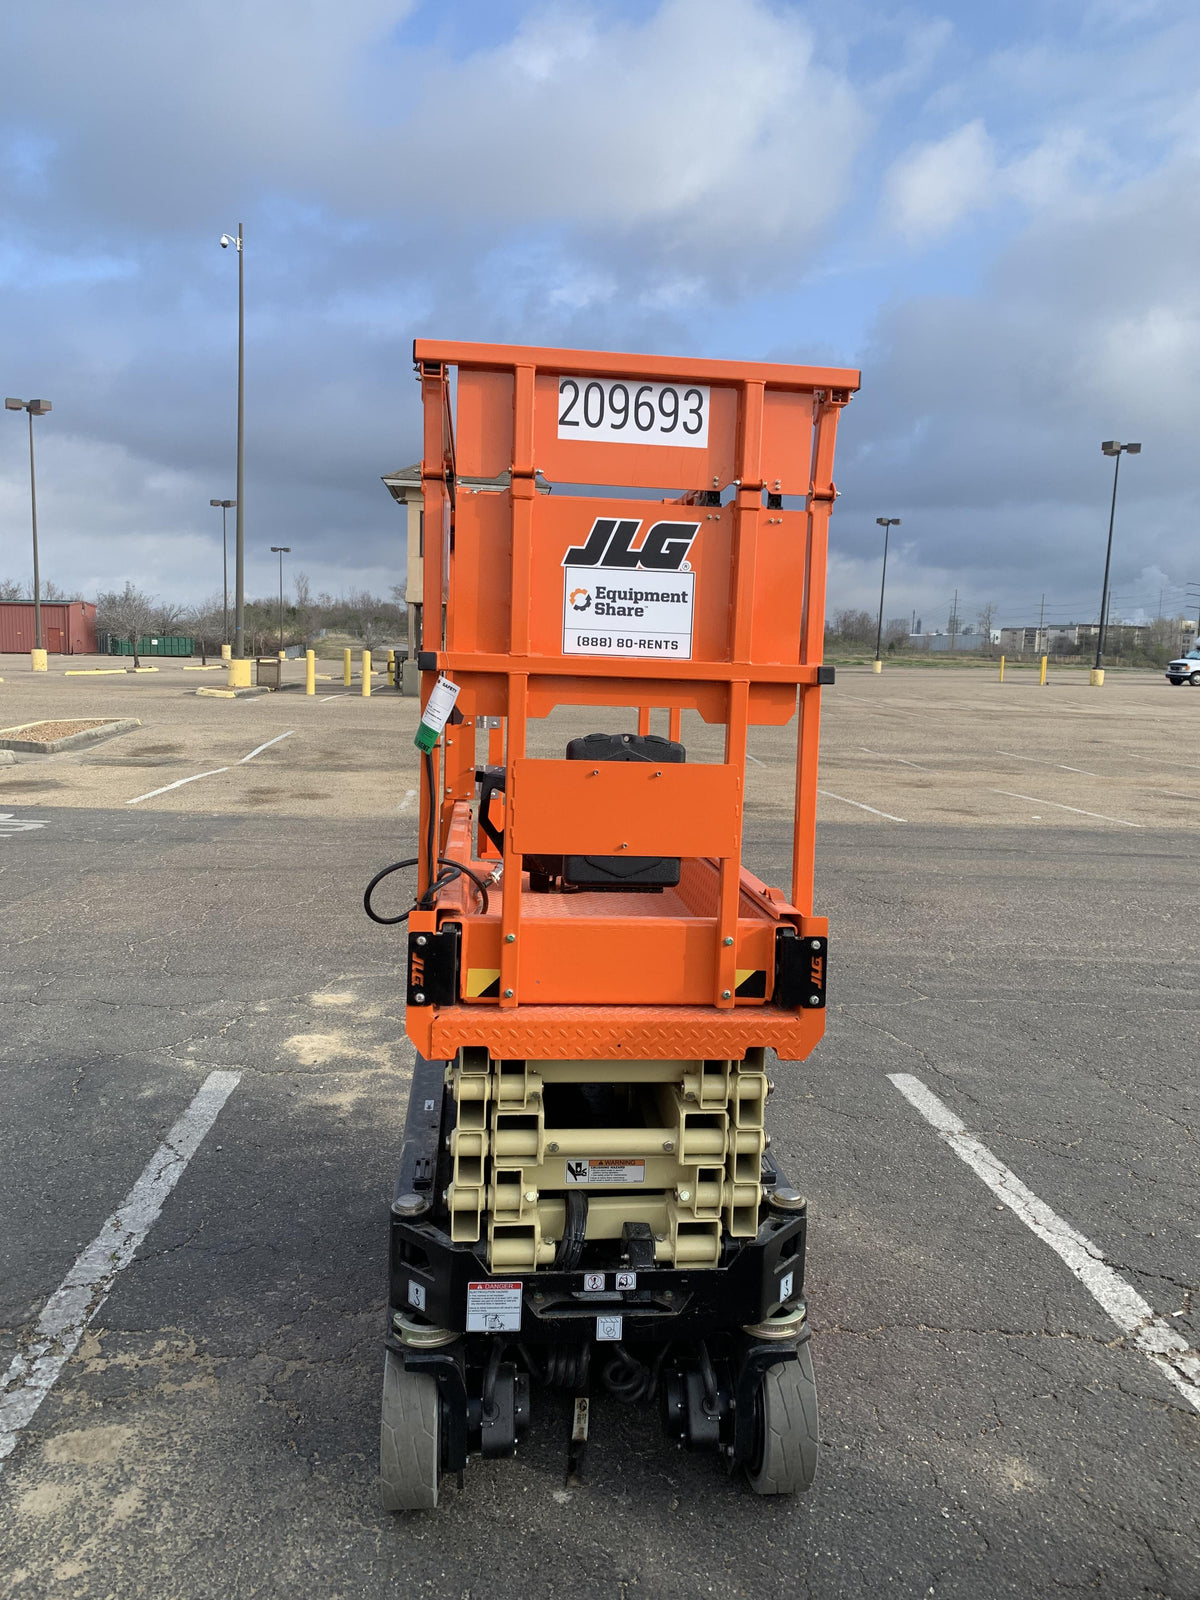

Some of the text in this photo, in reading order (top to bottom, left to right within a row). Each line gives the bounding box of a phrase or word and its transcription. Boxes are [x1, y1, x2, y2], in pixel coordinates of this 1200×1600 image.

[558, 379, 704, 435] 209693
[562, 518, 701, 571] JLG
[594, 586, 689, 605] Equipment
[594, 602, 645, 618] Share
[576, 635, 679, 651] (888) 80-RENTS
[442, 682, 457, 693] SAFETY
[411, 952, 425, 988] JLG
[810, 955, 823, 990] JLG
